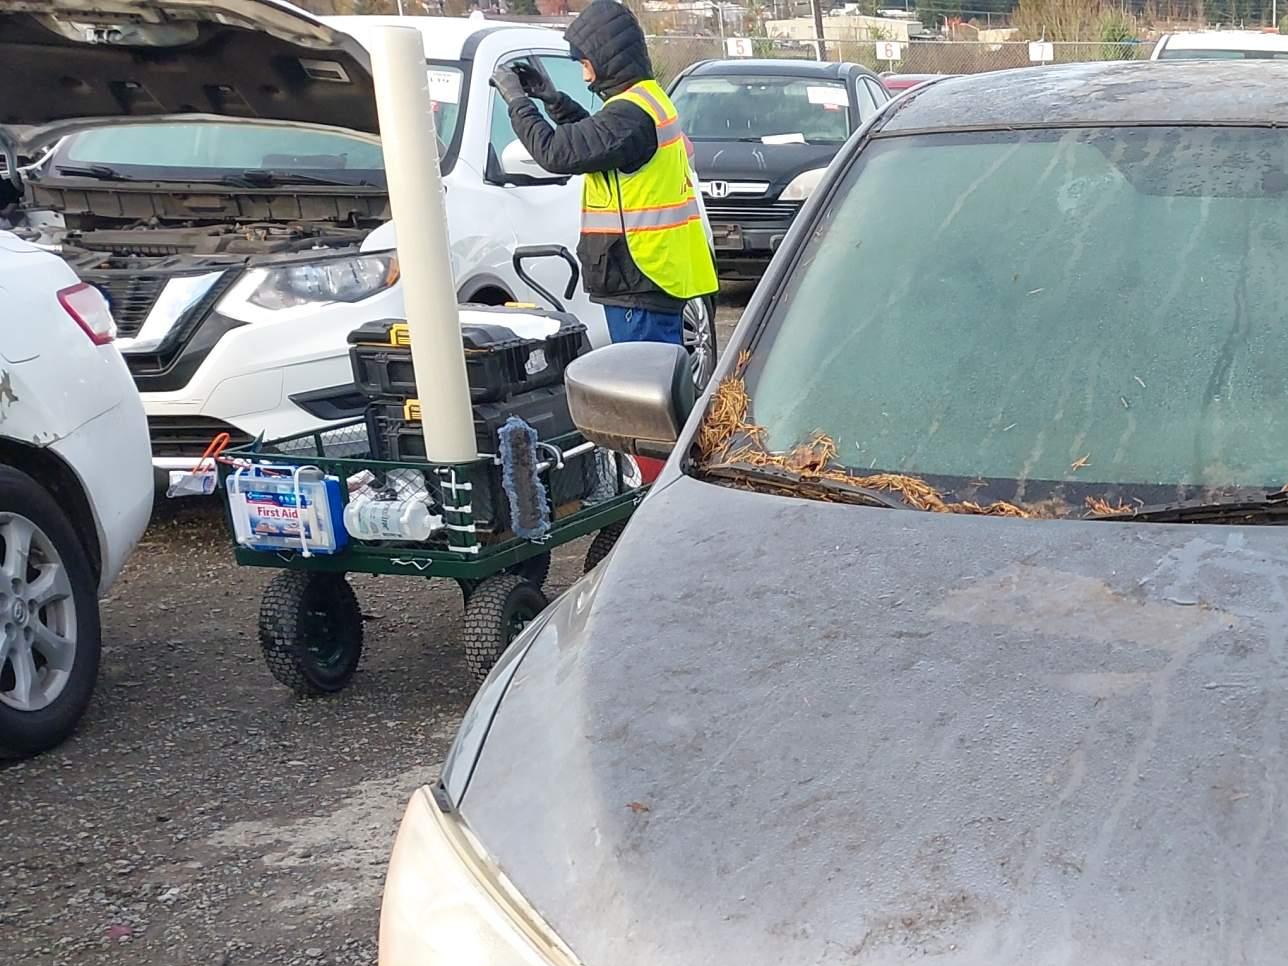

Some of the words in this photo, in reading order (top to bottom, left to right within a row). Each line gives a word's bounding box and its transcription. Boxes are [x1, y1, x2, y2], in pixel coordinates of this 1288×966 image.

[735, 39, 745, 55] 5
[884, 42, 893, 58] 6
[1039, 45, 1046, 59] 7
[257, 506, 280, 518] First
[281, 508, 299, 519] Aid
